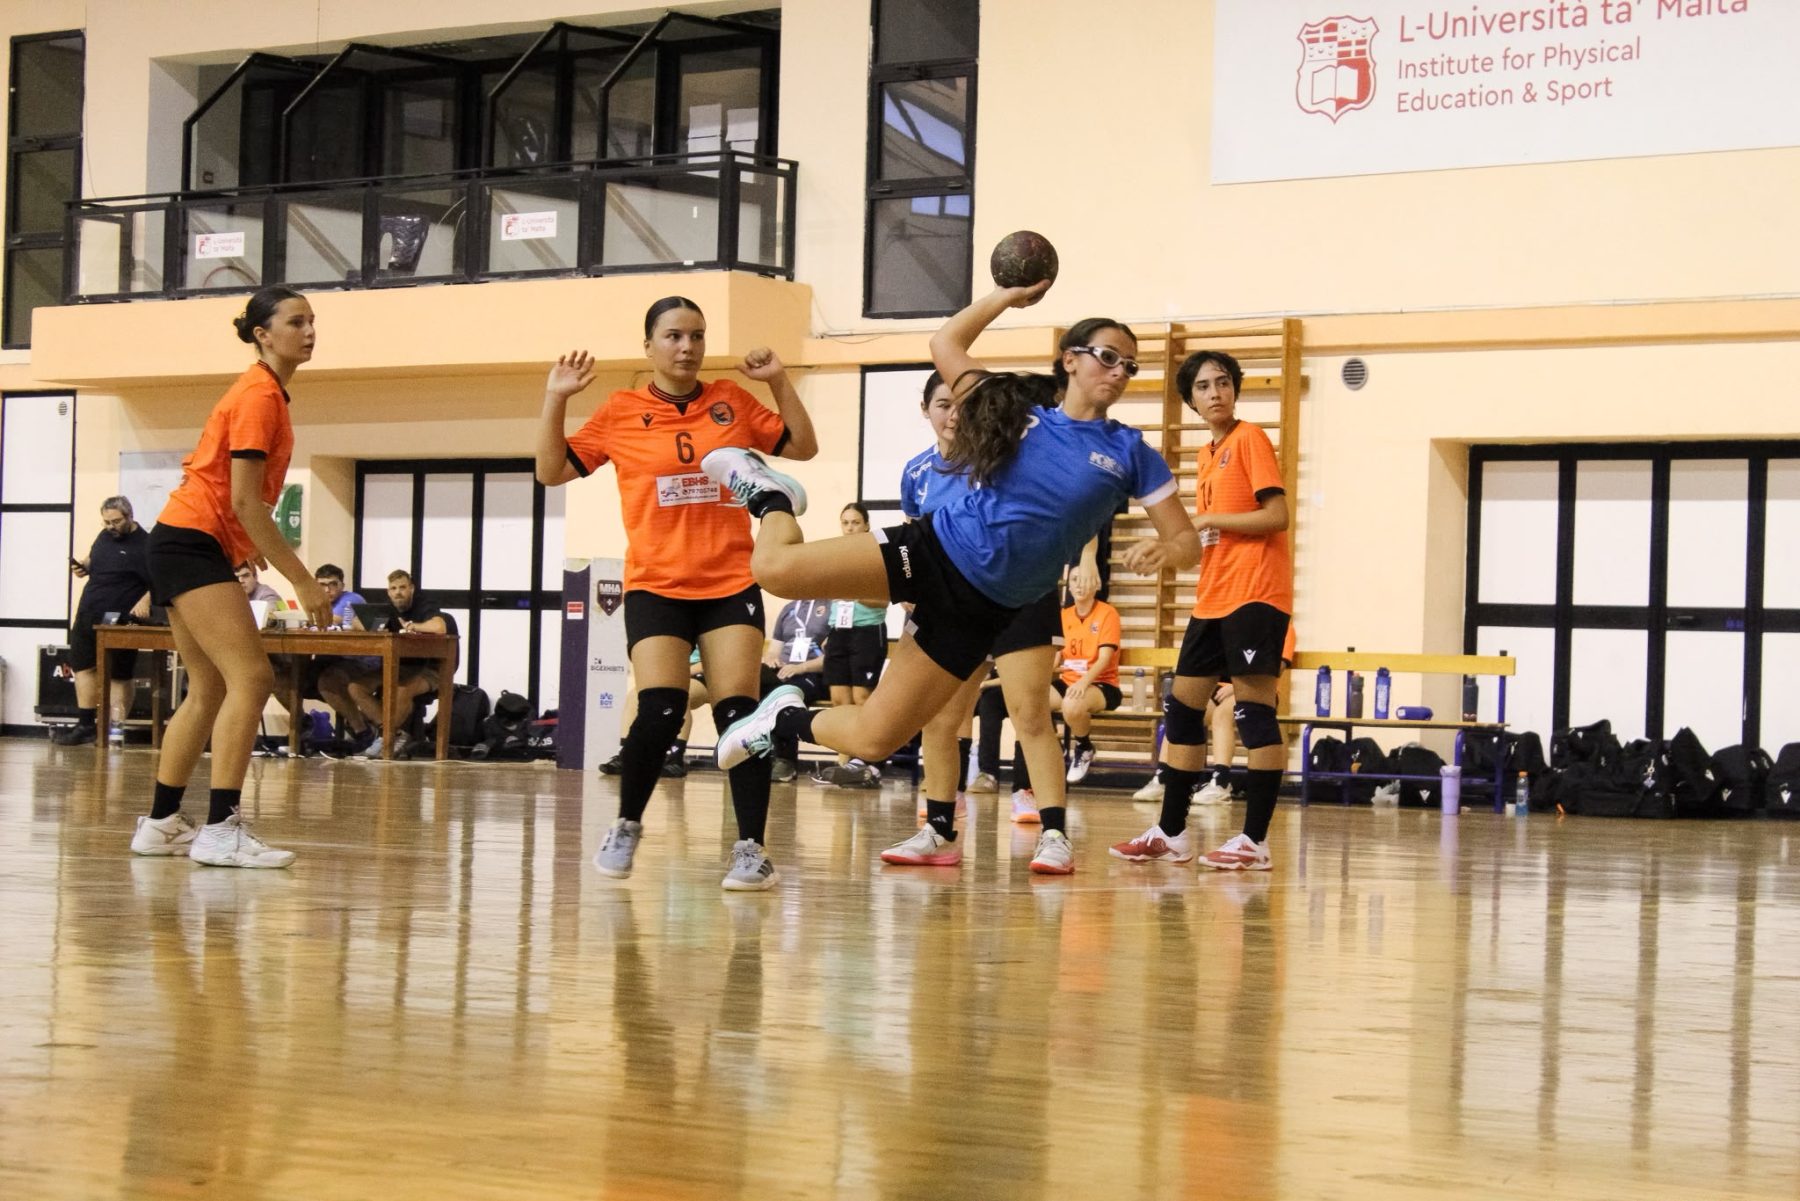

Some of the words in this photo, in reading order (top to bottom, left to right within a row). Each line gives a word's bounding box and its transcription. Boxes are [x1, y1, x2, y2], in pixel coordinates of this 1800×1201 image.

[1399, 0, 1589, 42] L-Università
[1398, 53, 1494, 79] Institute
[1502, 47, 1535, 71] for
[1544, 36, 1641, 71] Physical
[1397, 84, 1513, 113] Education
[1522, 82, 1538, 104] &
[1546, 77, 1613, 106] Sport
[675, 431, 695, 464] 6
[898, 545, 912, 579] Kempa
[599, 583, 621, 593] MHA
